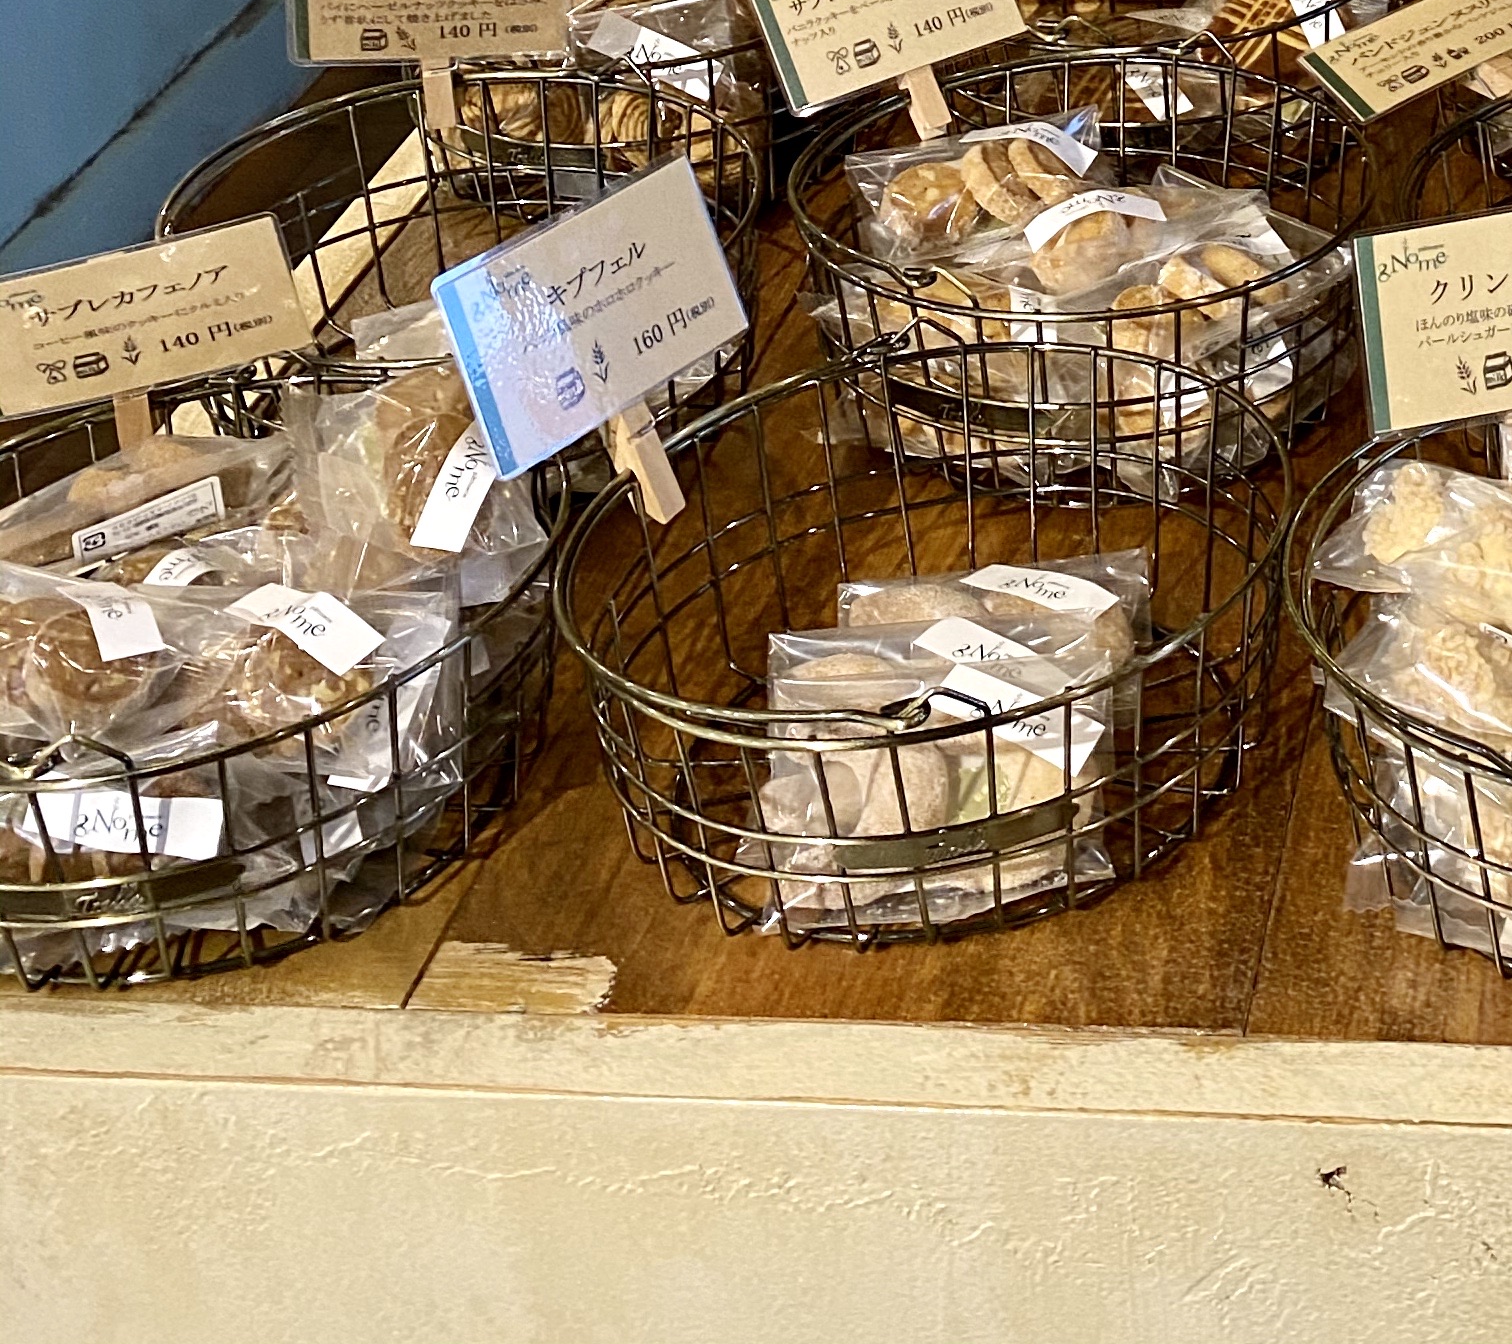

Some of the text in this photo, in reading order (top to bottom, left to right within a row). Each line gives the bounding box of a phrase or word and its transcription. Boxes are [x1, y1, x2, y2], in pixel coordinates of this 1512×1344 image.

[913, 15, 943, 39] 140
[546, 242, 647, 308] キプフェル
[160, 331, 200, 354] 140
[634, 323, 664, 357] 160
